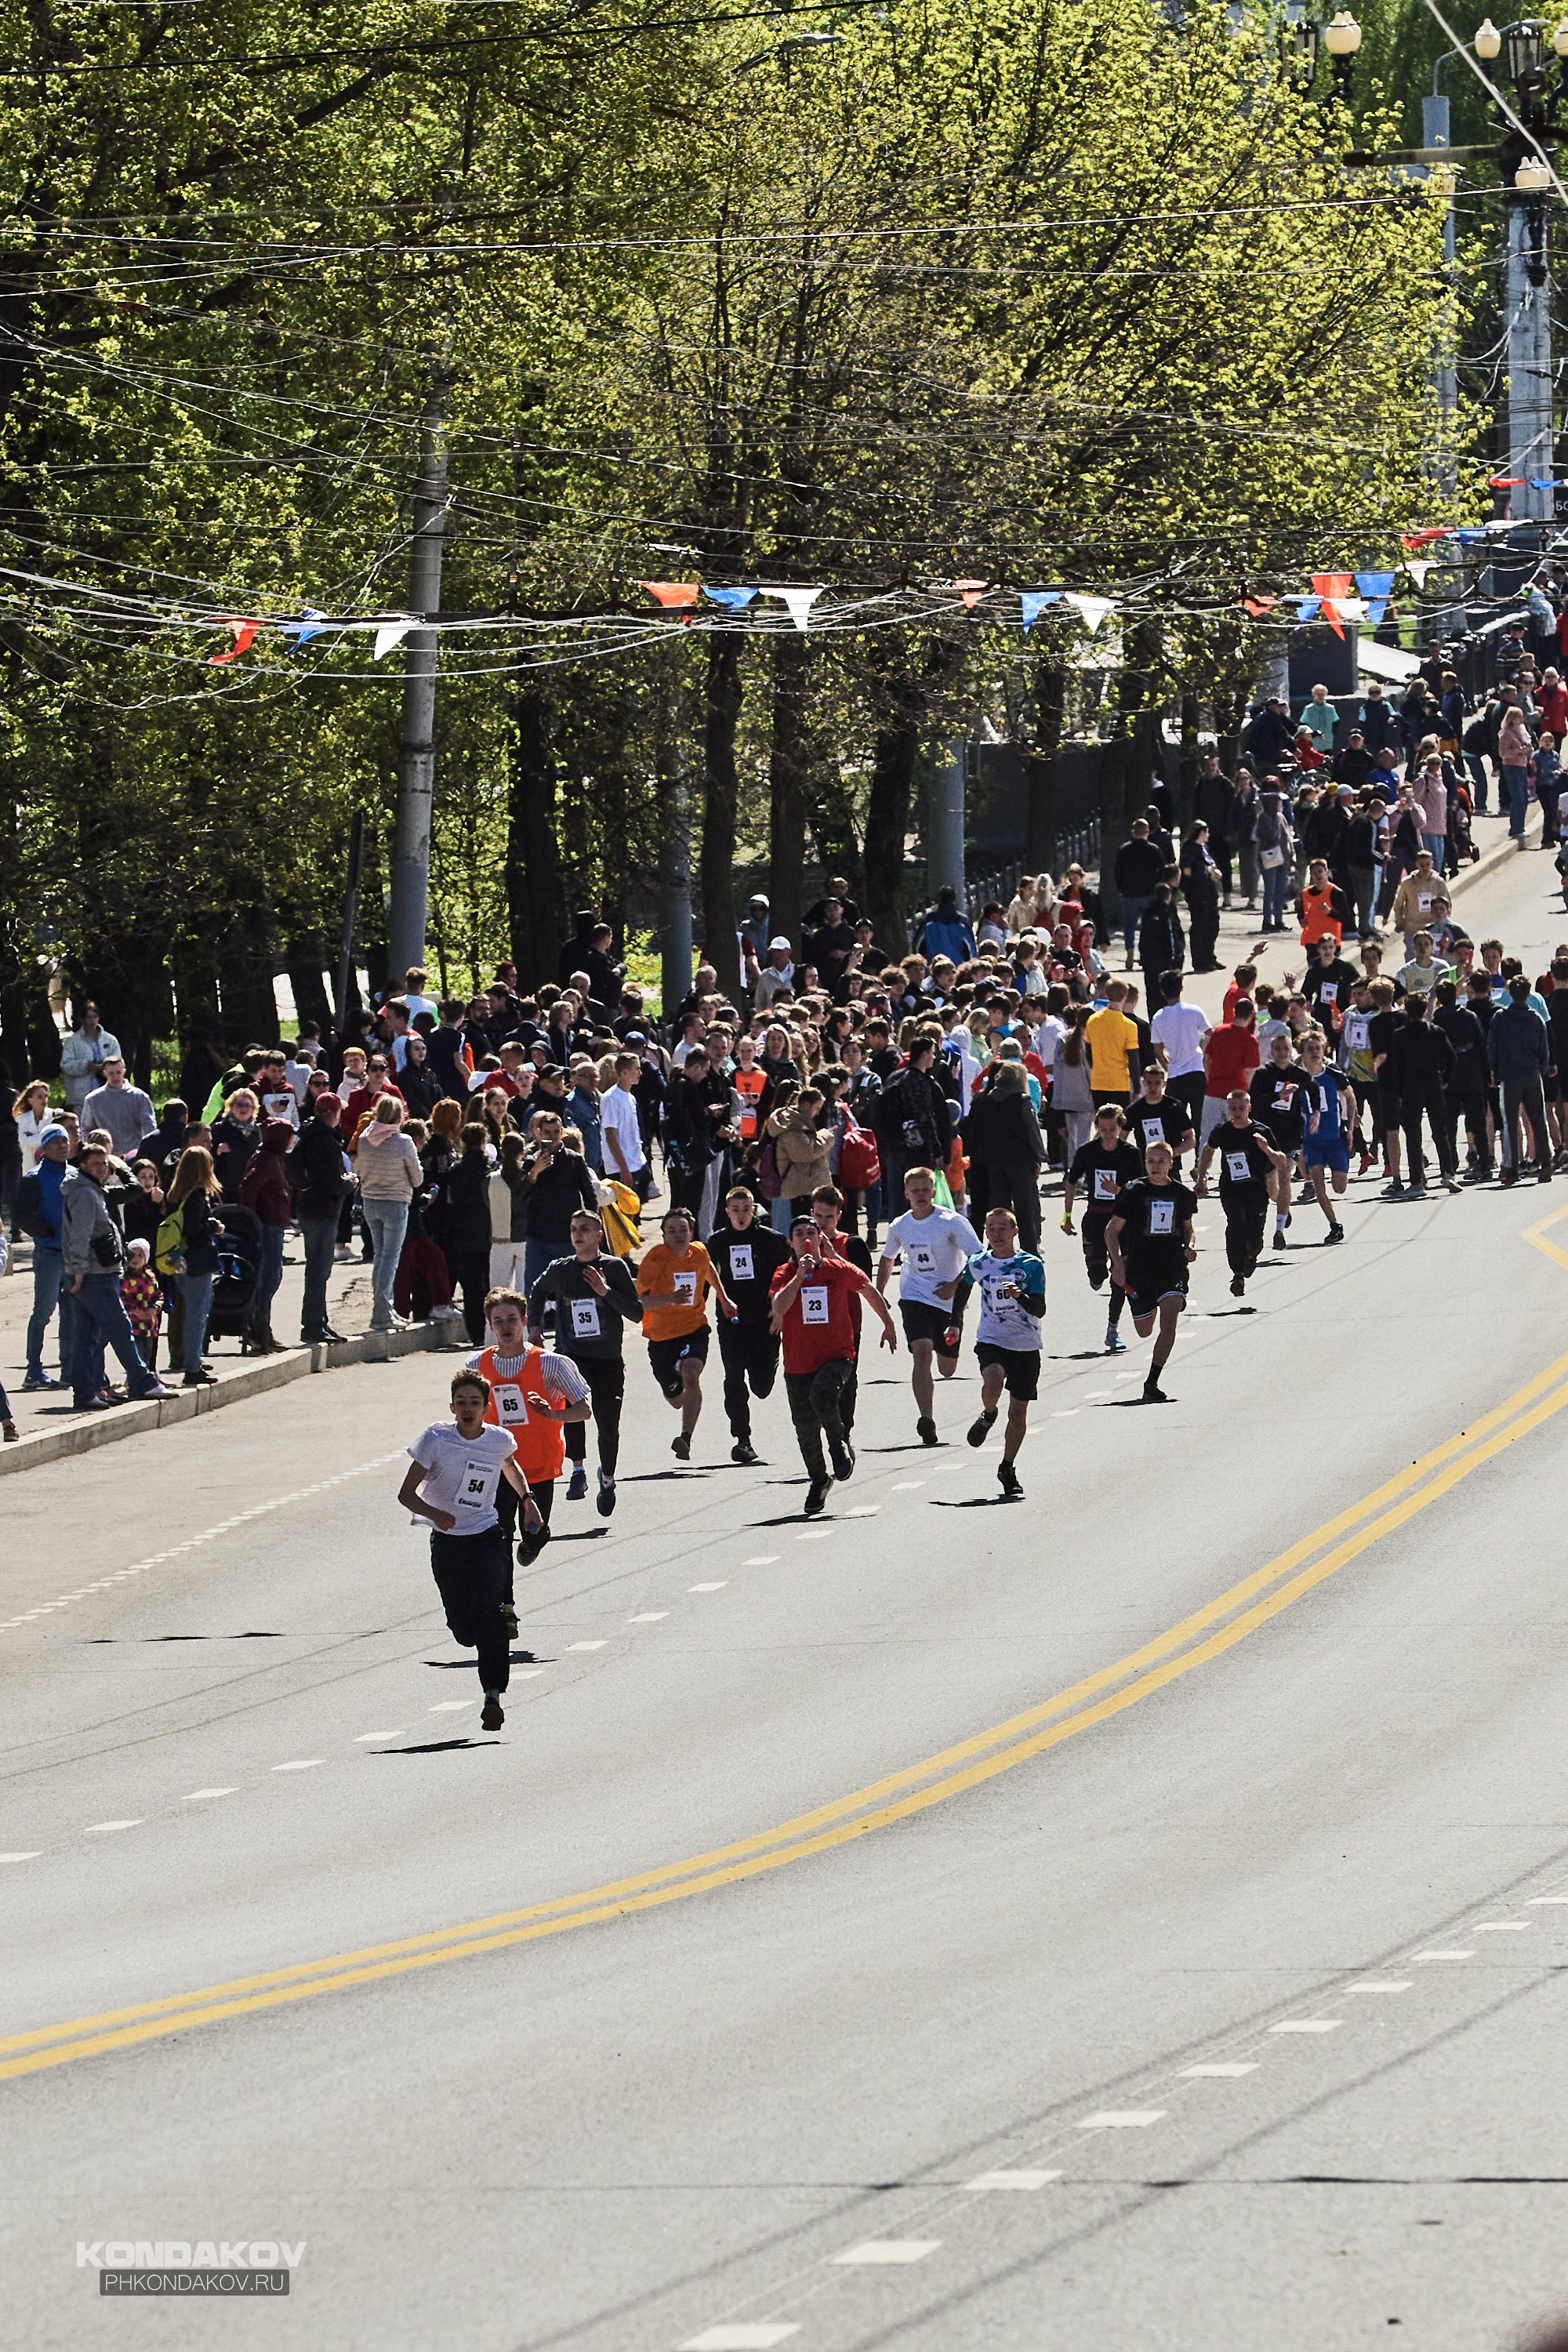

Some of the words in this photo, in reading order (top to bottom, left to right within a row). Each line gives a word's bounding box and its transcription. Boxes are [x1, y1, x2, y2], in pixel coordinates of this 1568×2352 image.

[1233, 1161, 1243, 1171] 15
[1160, 1213, 1166, 1222] 7
[735, 1257, 747, 1268] 24
[808, 1300, 822, 1311] 23
[578, 1312, 592, 1323] 35
[503, 1399, 518, 1411] 65
[468, 1479, 485, 1494] 54
